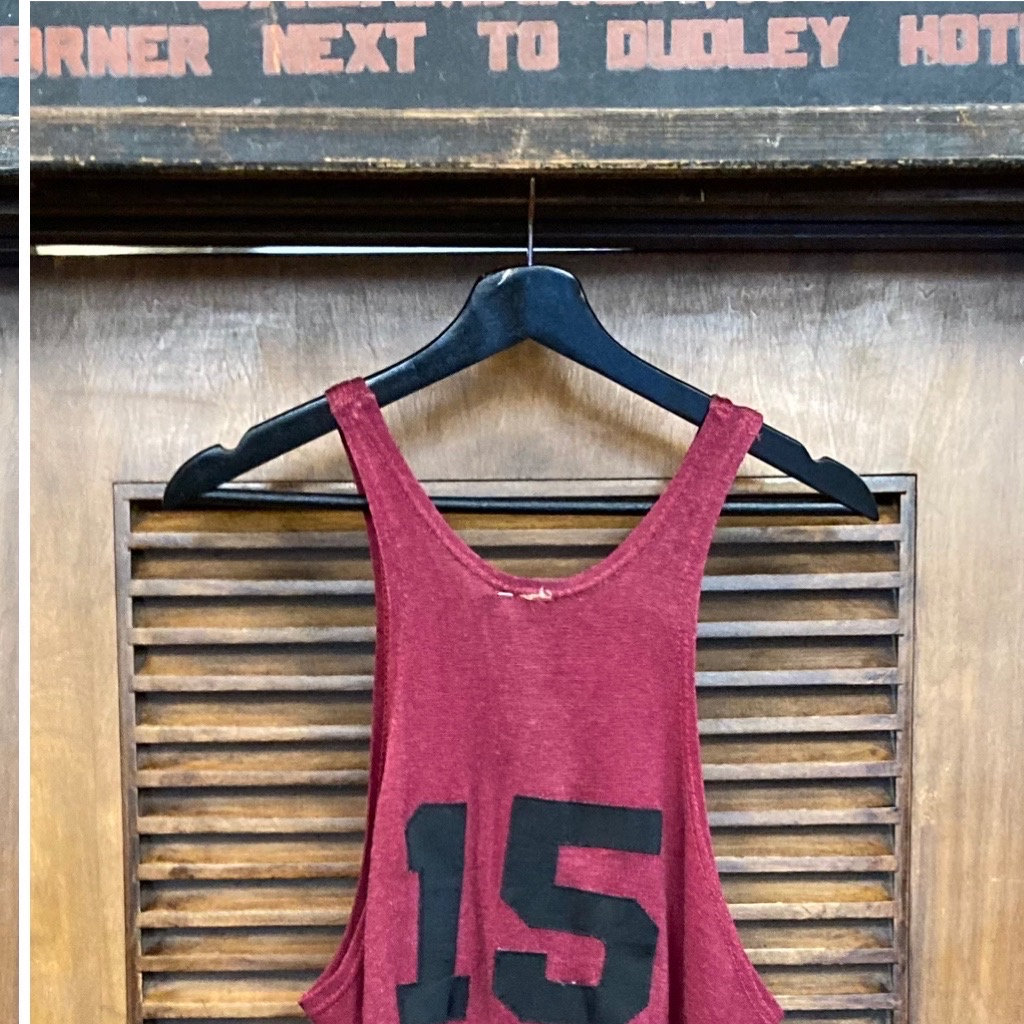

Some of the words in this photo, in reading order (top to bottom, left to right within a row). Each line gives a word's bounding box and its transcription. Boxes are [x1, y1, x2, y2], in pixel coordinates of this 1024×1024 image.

[262, 22, 426, 75] NEXT
[477, 20, 559, 71] TO
[606, 17, 849, 70] DUDLEY
[899, 13, 1024, 66] HOT
